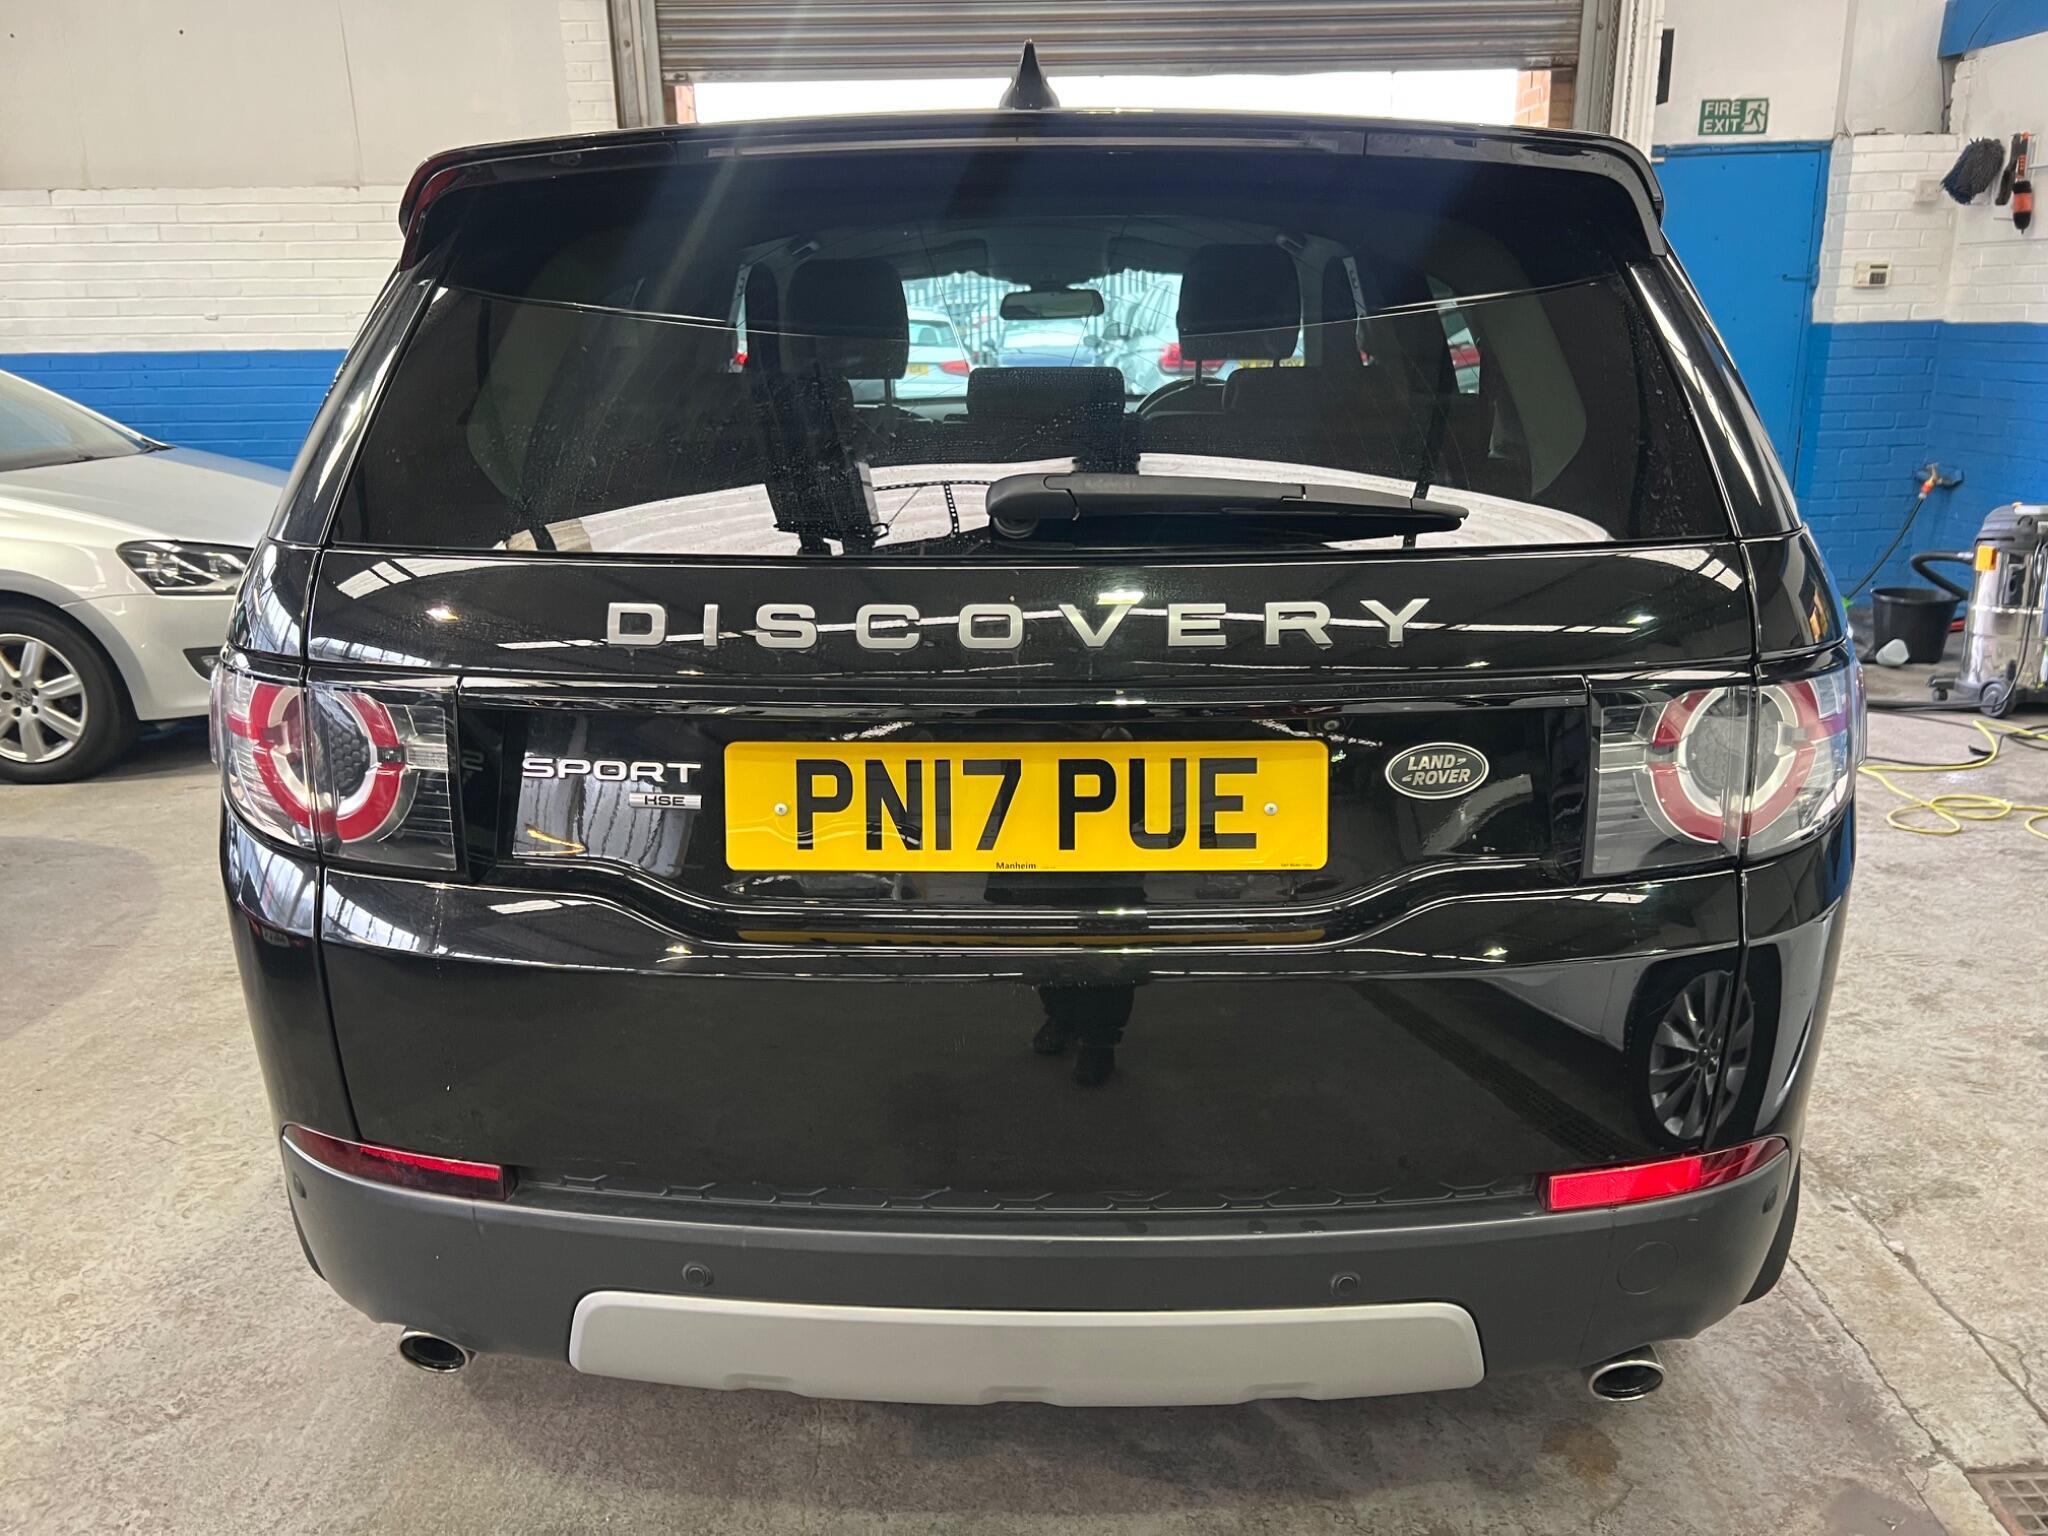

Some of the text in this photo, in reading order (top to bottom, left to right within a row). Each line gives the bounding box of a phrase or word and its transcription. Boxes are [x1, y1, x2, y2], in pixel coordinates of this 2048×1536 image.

[1704, 101, 1741, 116] FIRE
[1702, 118, 1741, 133] EXIT
[606, 598, 1430, 649] DISCOVERY
[521, 757, 702, 784] SPORT
[1407, 754, 1456, 771] LAND
[1411, 768, 1471, 786] ROVER
[643, 794, 686, 808] HSE
[796, 757, 1258, 851] PN17 PUE
[995, 861, 1037, 870] Manheim
